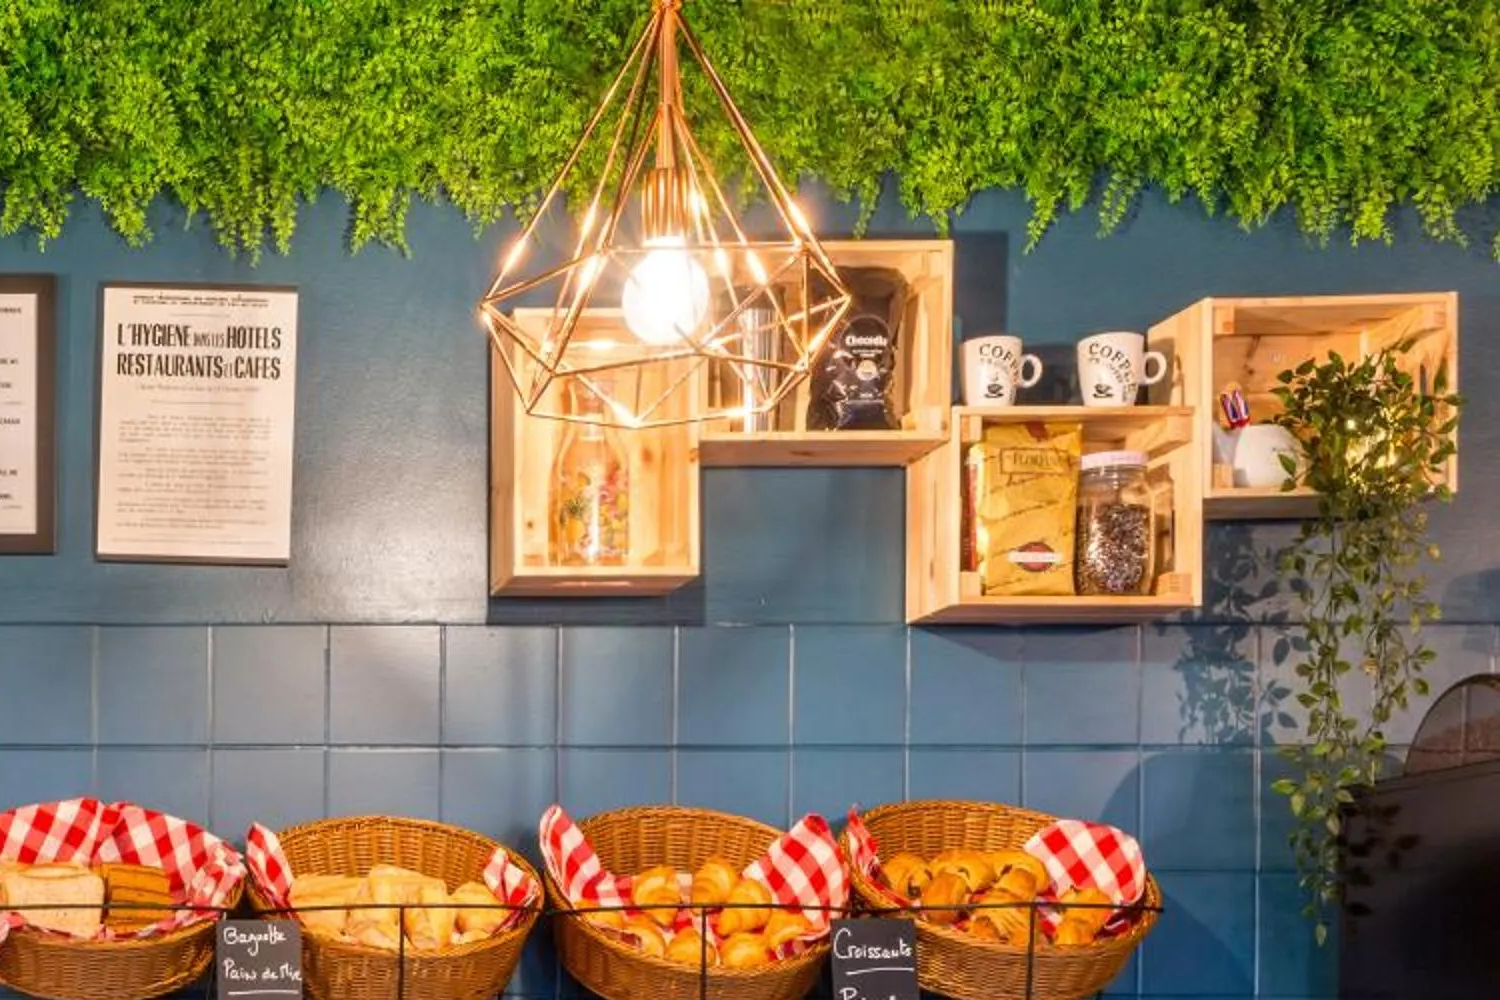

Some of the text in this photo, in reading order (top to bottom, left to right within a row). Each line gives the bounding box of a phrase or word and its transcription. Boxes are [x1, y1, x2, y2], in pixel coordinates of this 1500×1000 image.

[117, 323, 191, 347] L'HYGIENE
[226, 325, 281, 349] HOTELS
[117, 352, 223, 379] RESTAURANTS
[234, 355, 281, 380] CAFES
[223, 924, 287, 957] Baguette
[834, 927, 913, 959] Croissants
[261, 966, 278, 980] de
